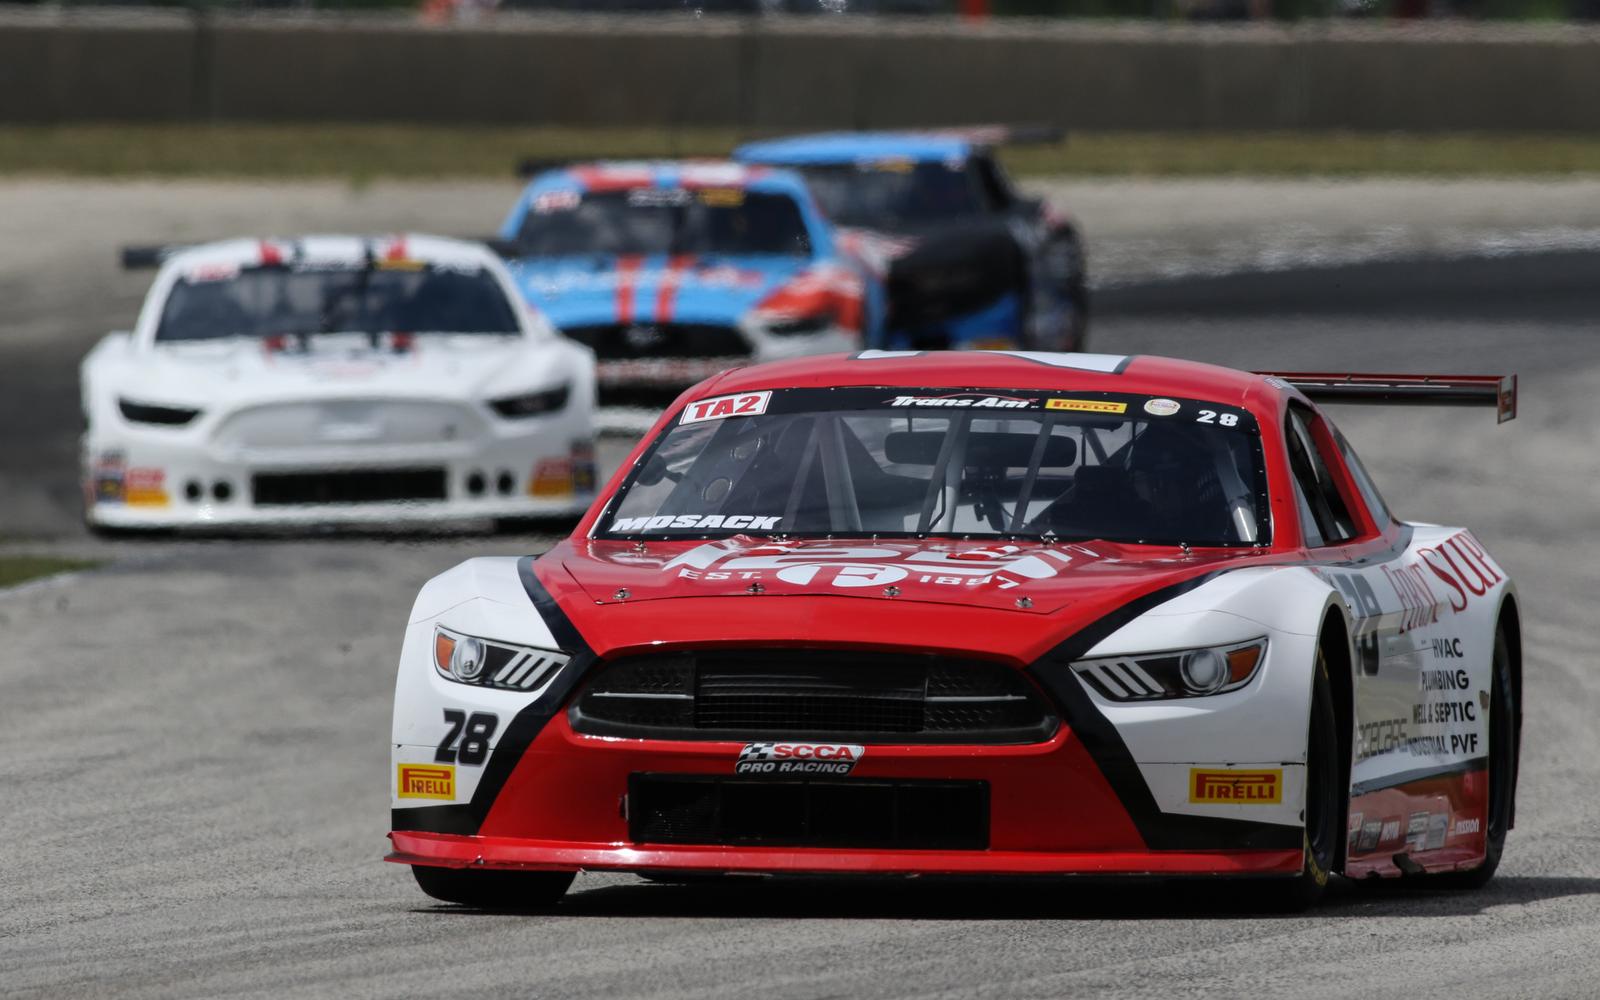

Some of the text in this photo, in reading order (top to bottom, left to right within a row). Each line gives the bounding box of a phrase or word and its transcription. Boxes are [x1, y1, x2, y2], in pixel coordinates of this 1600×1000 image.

[694, 395, 762, 418] TA2
[891, 396, 974, 408] Trans
[972, 397, 1030, 409] Am
[1053, 400, 1120, 411] PIRELLI
[1196, 409, 1239, 427] 28
[609, 514, 783, 532] MOSACK
[679, 568, 763, 580] EST.
[1432, 638, 1464, 658] HVAC
[1421, 669, 1470, 691] PLUMBING
[1434, 701, 1475, 723] SEPTIC
[433, 708, 499, 767] 28
[1450, 733, 1479, 754] PVF
[774, 745, 855, 760] SCCA
[740, 762, 850, 773] PRO RACING
[402, 768, 451, 795] PIRELLI
[1195, 773, 1276, 799] PIRELLI
